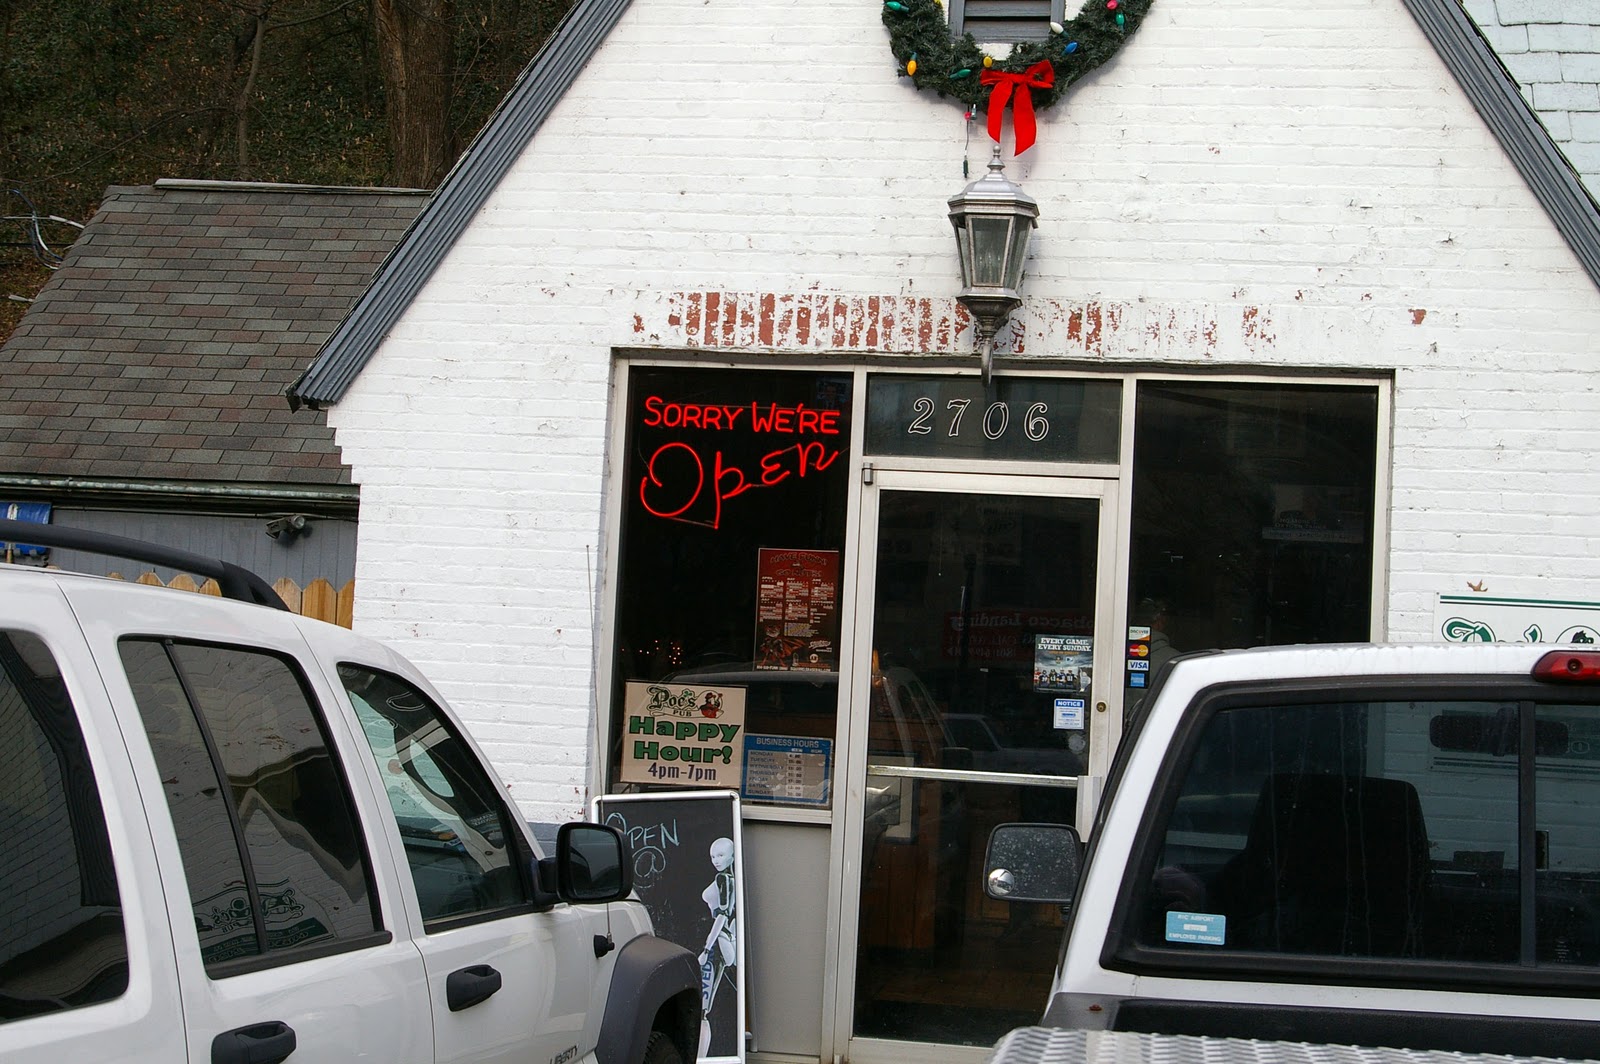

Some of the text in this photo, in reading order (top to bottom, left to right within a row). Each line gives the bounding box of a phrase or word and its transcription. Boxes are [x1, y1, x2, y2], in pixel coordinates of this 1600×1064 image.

[644, 395, 841, 435] SORRY WE'RE
[907, 397, 1051, 442] 2706
[1037, 643, 1062, 651] EVERY
[1040, 637, 1065, 645] EVERY
[1130, 661, 1148, 669] VISA
[672, 709, 692, 717] PUB
[629, 715, 742, 743] Happy
[756, 737, 820, 748] BUSINESS HOURS
[633, 740, 733, 765] Hour!
[649, 763, 716, 780] 4pm-7pm
